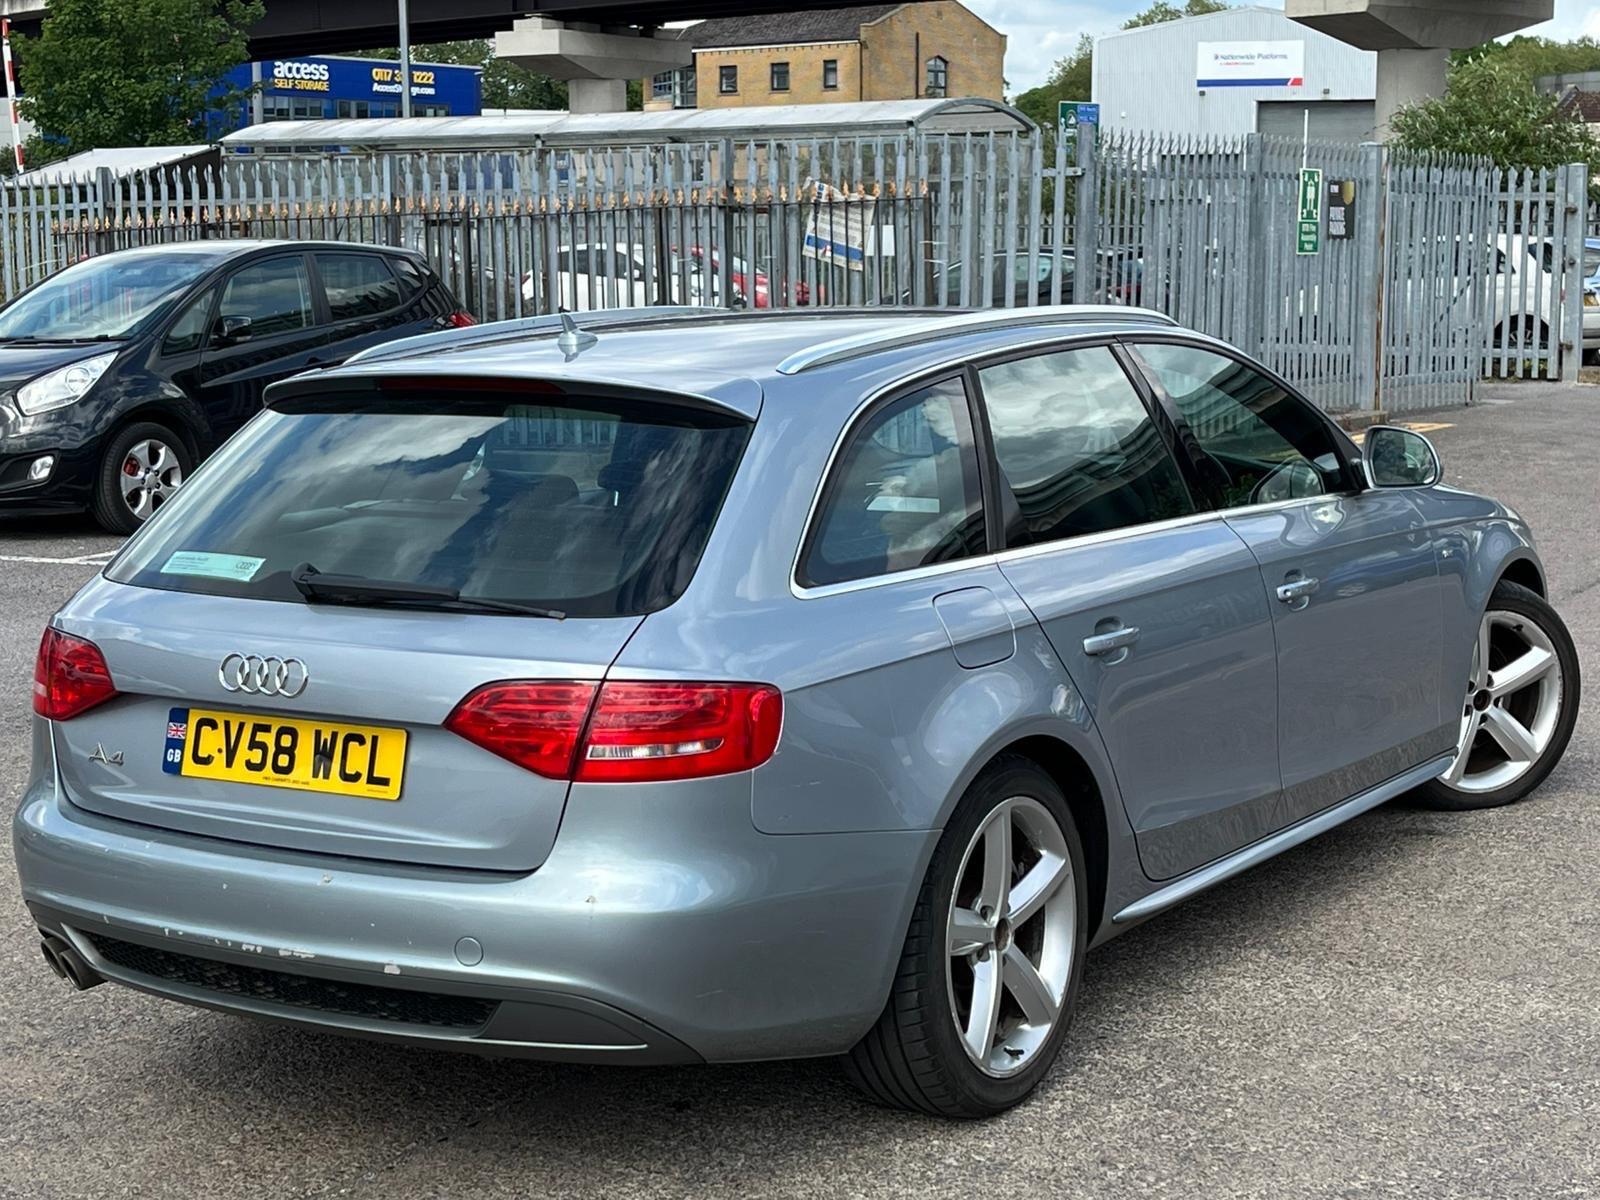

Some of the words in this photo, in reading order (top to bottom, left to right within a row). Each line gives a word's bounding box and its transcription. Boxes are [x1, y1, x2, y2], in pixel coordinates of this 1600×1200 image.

[273, 61, 329, 80] access
[274, 79, 294, 89] SELF
[294, 80, 330, 91] STORAGE
[88, 742, 124, 766] A4
[167, 749, 181, 762] GB
[191, 717, 299, 775] CV58
[312, 729, 391, 787] WCL
